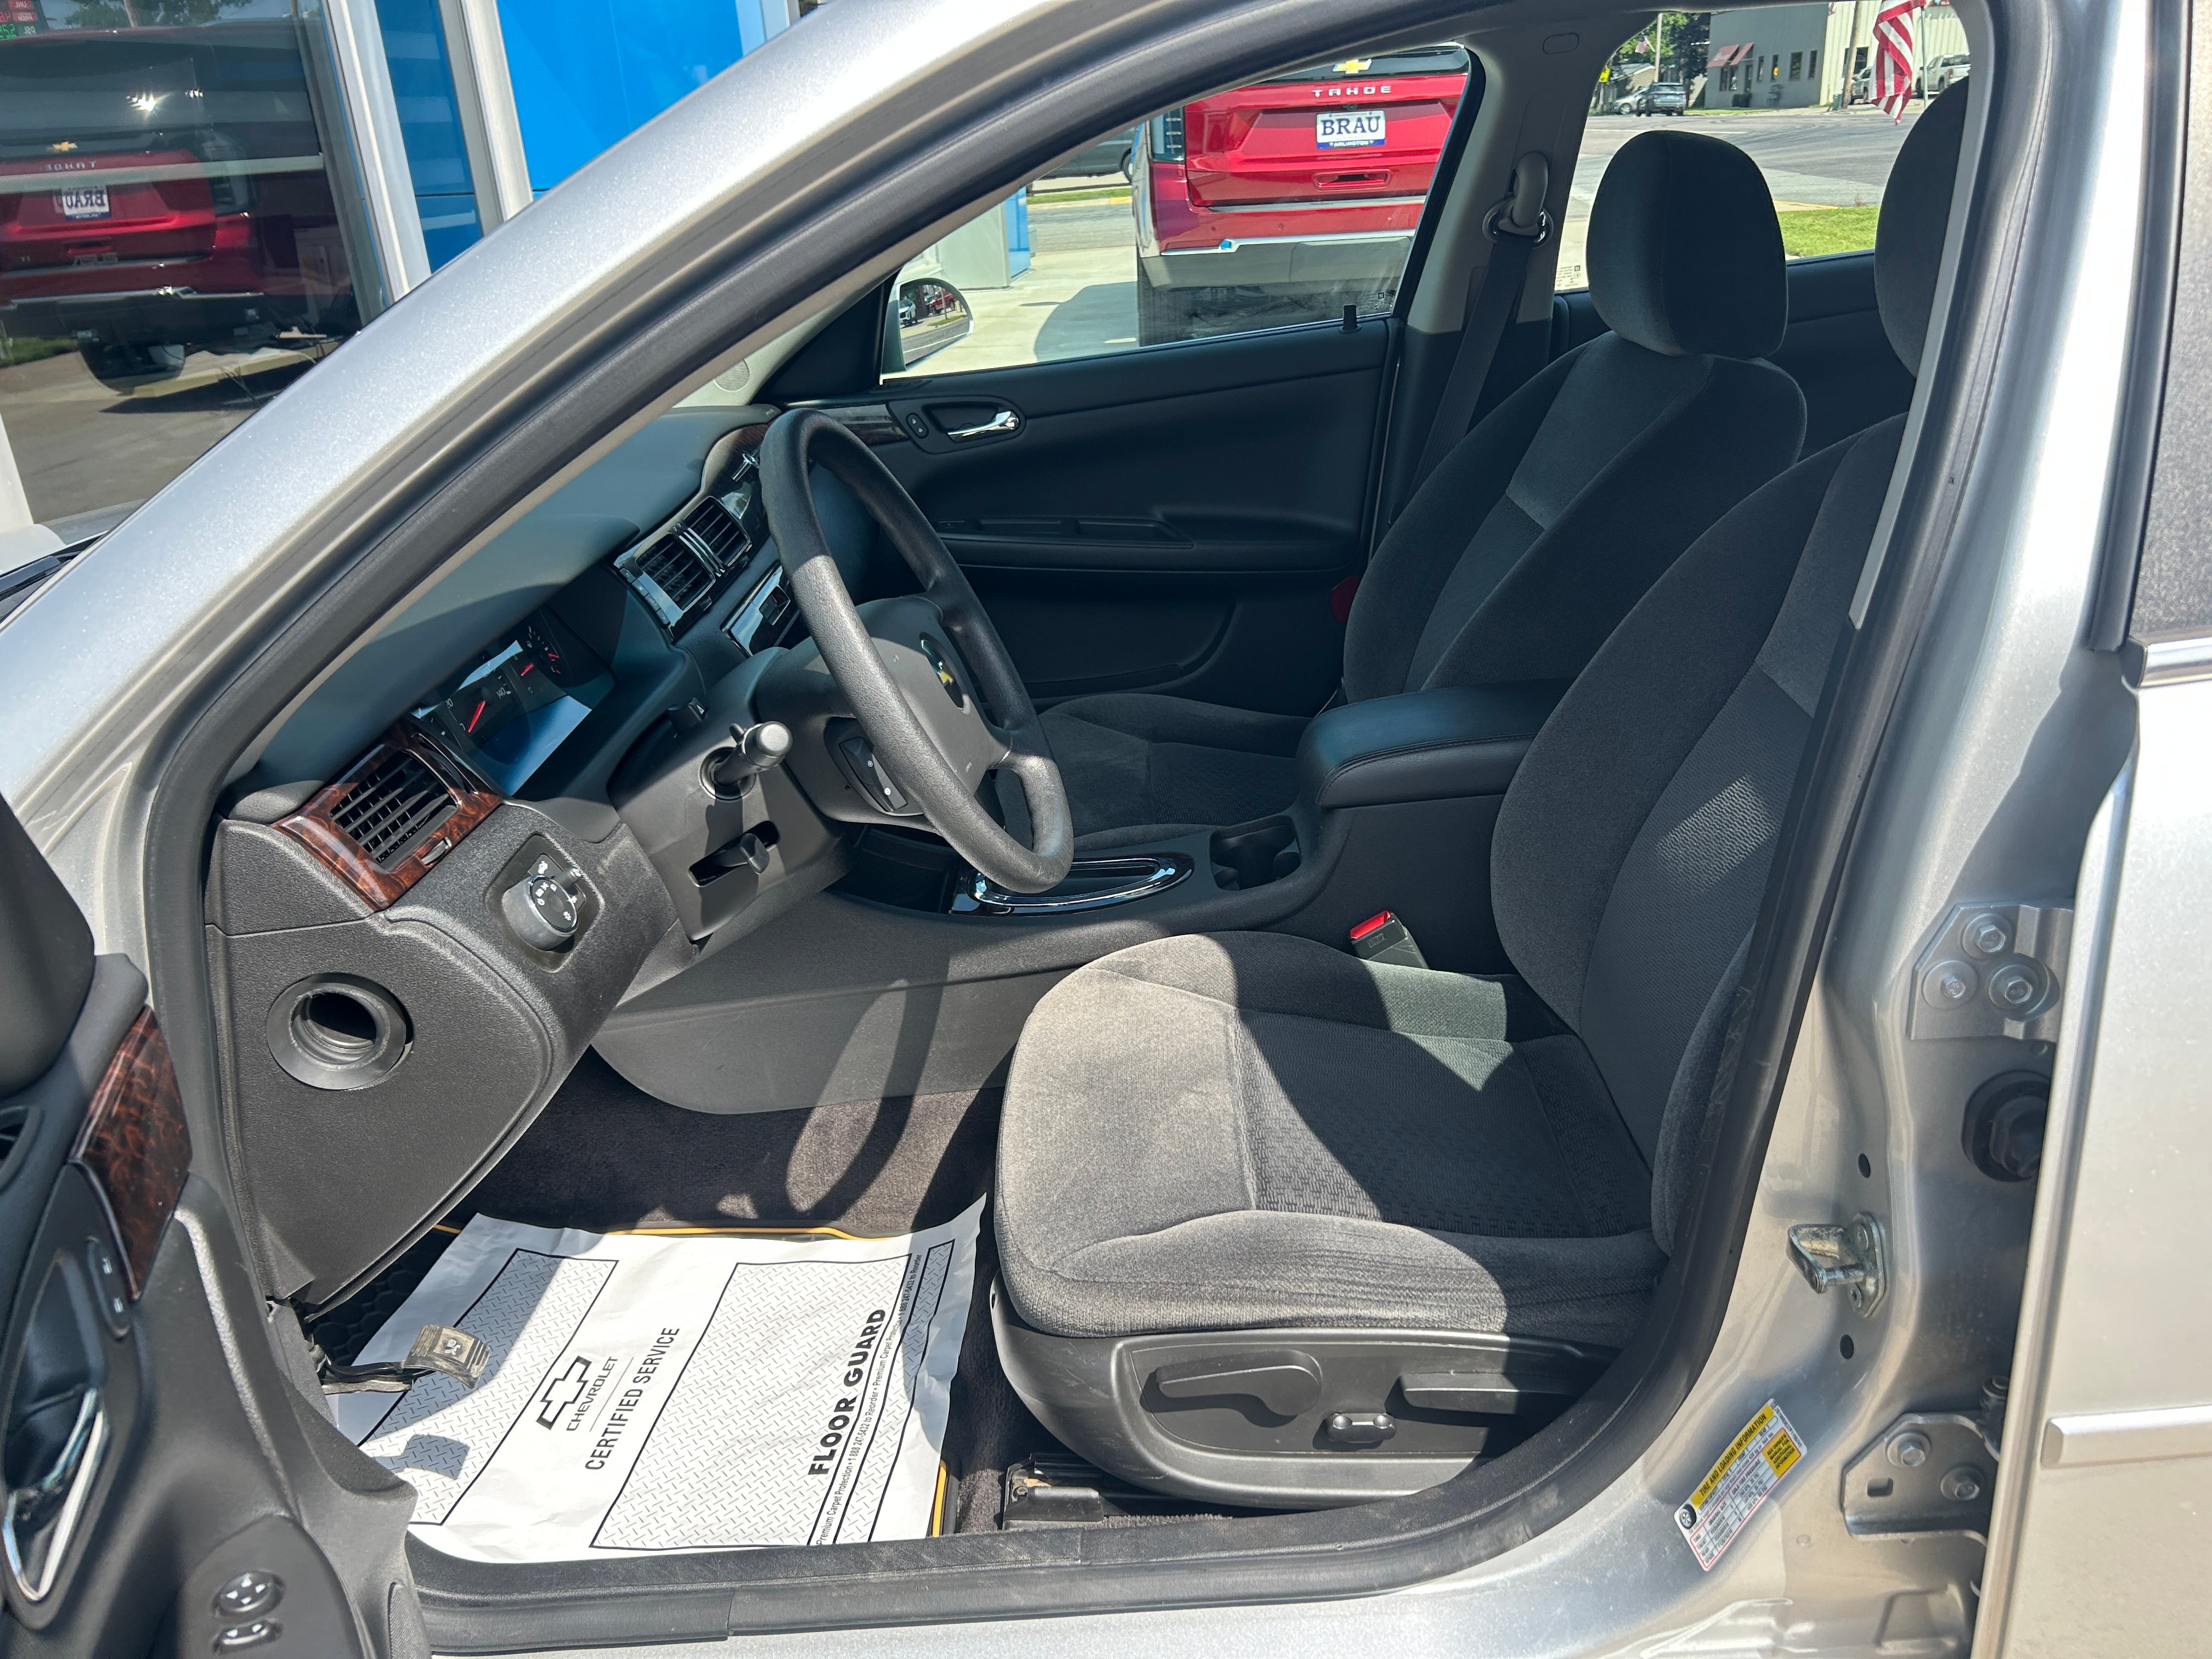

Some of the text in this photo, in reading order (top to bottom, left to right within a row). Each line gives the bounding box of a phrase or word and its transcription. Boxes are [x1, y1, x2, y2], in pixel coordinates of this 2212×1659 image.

[1311, 85, 1392, 98] TAHOE
[1321, 116, 1381, 136] BRAU
[496, 687, 506, 699] 140
[910, 1254, 922, 1273] Reorder
[901, 1280, 915, 1302] 247-5432
[879, 1342, 893, 1358] Carpet
[872, 1361, 887, 1386] Premium
[566, 1356, 618, 1431] CHEVROLET
[585, 1328, 680, 1470] CERTIFIED SERVICE
[808, 1309, 885, 1475] FLOOR GUARD
[865, 1392, 879, 1415] Reorder
[853, 1424, 870, 1446] 247-5432
[849, 1447, 860, 1457] 888
[1699, 1414, 1766, 1496] TIRE AND LOADING INFORMATION
[1745, 1459, 1760, 1477] PRESSURE
[834, 1466, 853, 1494] Protection
[827, 1496, 842, 1515] Carpet
[816, 1517, 834, 1545] Premium
